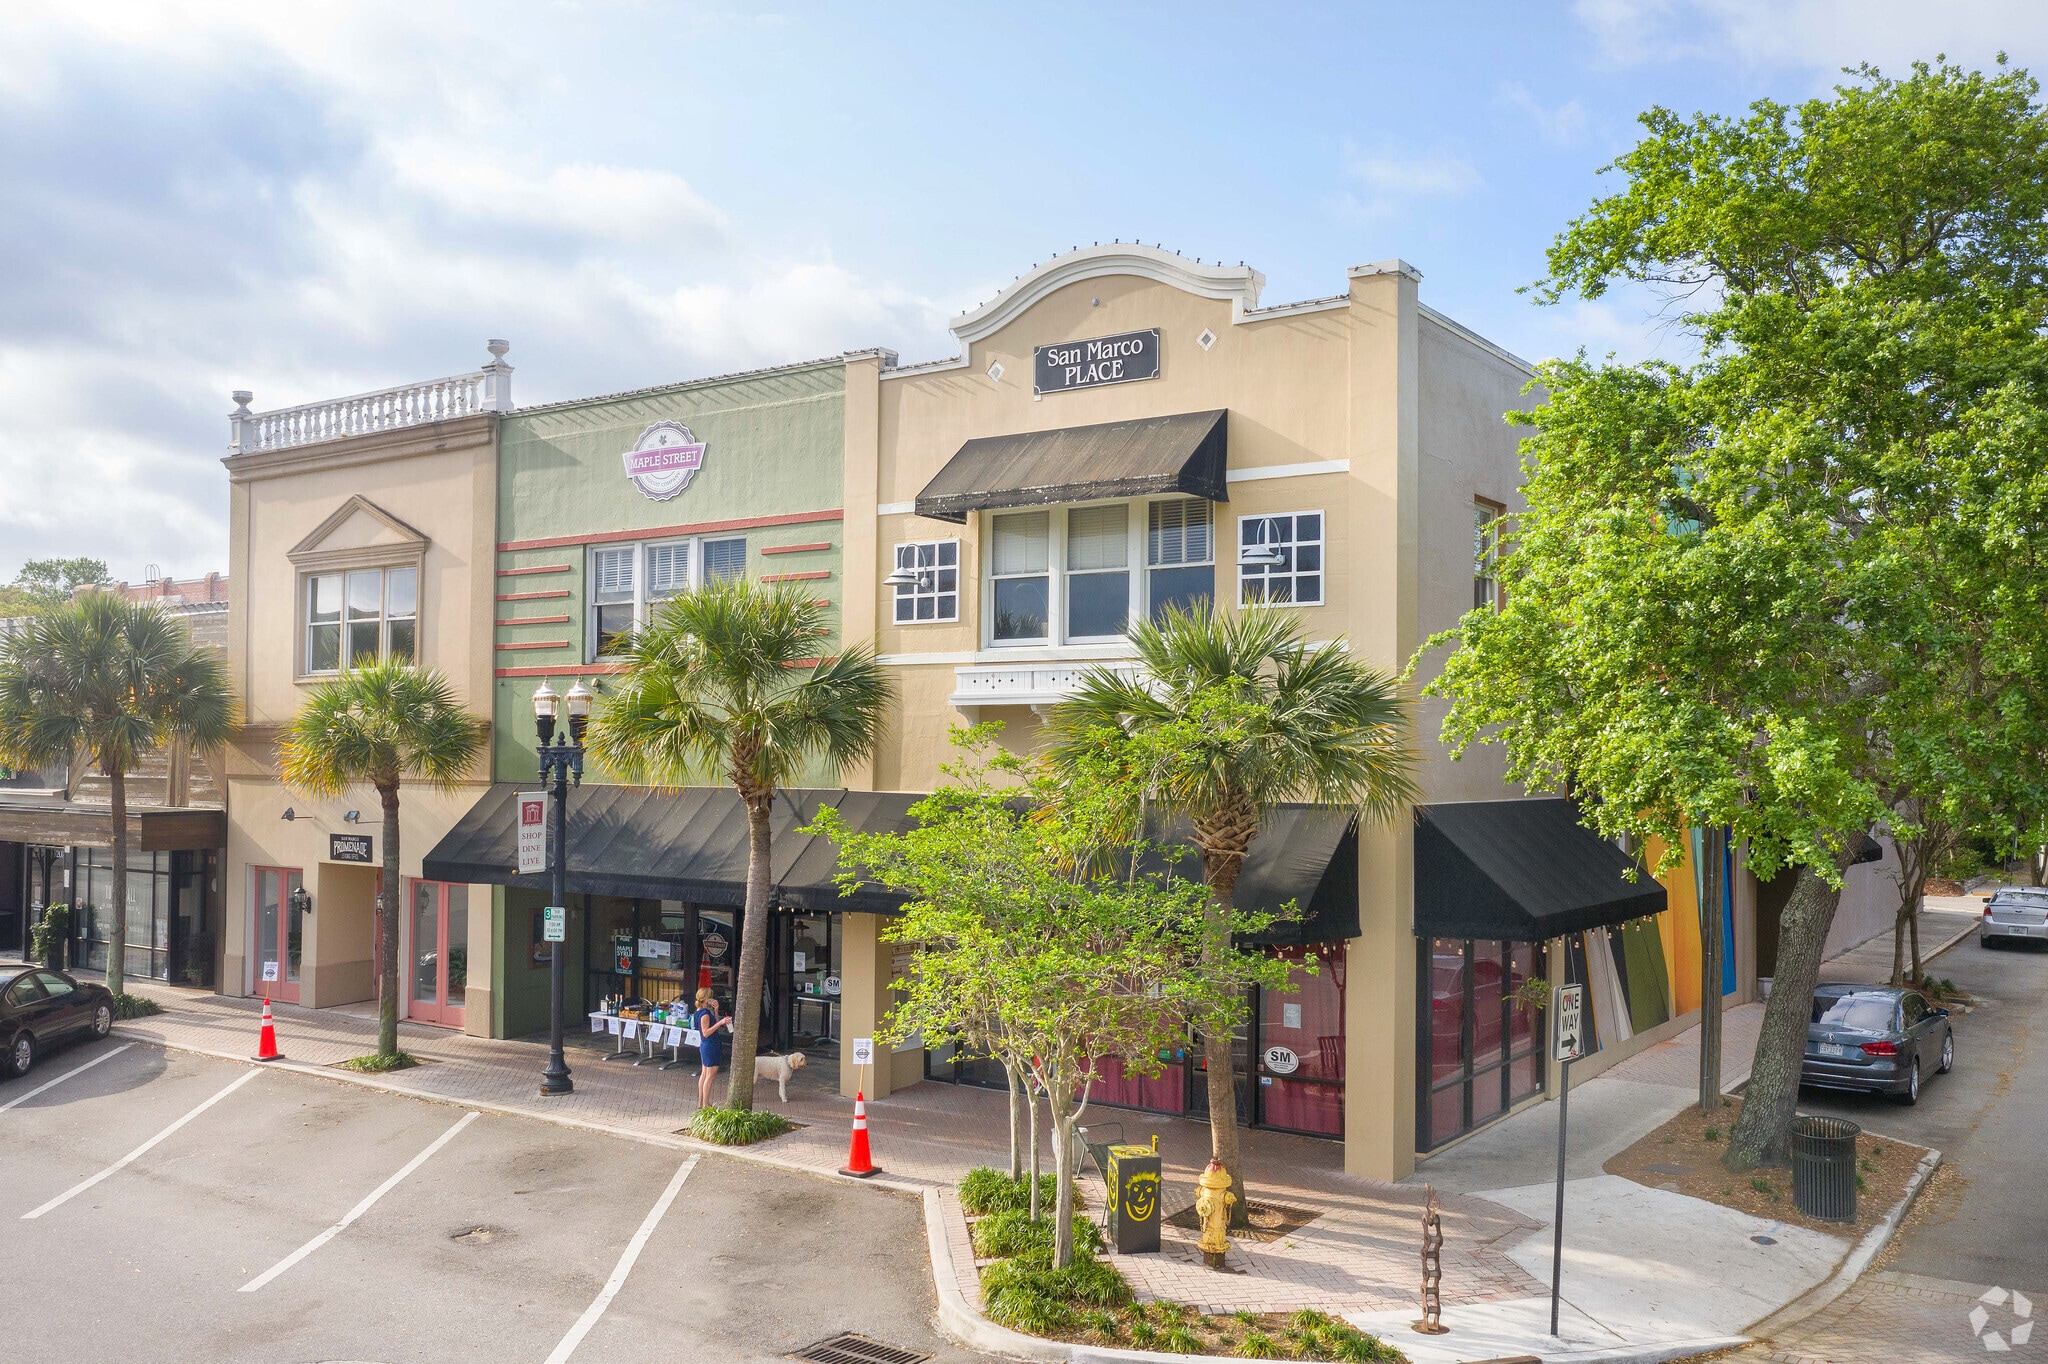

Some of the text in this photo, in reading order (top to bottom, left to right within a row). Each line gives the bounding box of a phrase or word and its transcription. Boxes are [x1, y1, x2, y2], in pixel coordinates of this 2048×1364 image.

[1047, 339, 1143, 367] San Marco
[1064, 359, 1124, 385] PLACE
[630, 451, 698, 469] MAPLE STREET
[521, 832, 542, 840] SHOP
[334, 840, 367, 858] PROMENADE
[522, 845, 541, 853] DINE
[522, 858, 541, 866] LIVE
[545, 910, 551, 919] 3
[1562, 993, 1579, 1012] ONE
[1562, 1013, 1579, 1032] WAY
[1270, 1051, 1290, 1063] SM
